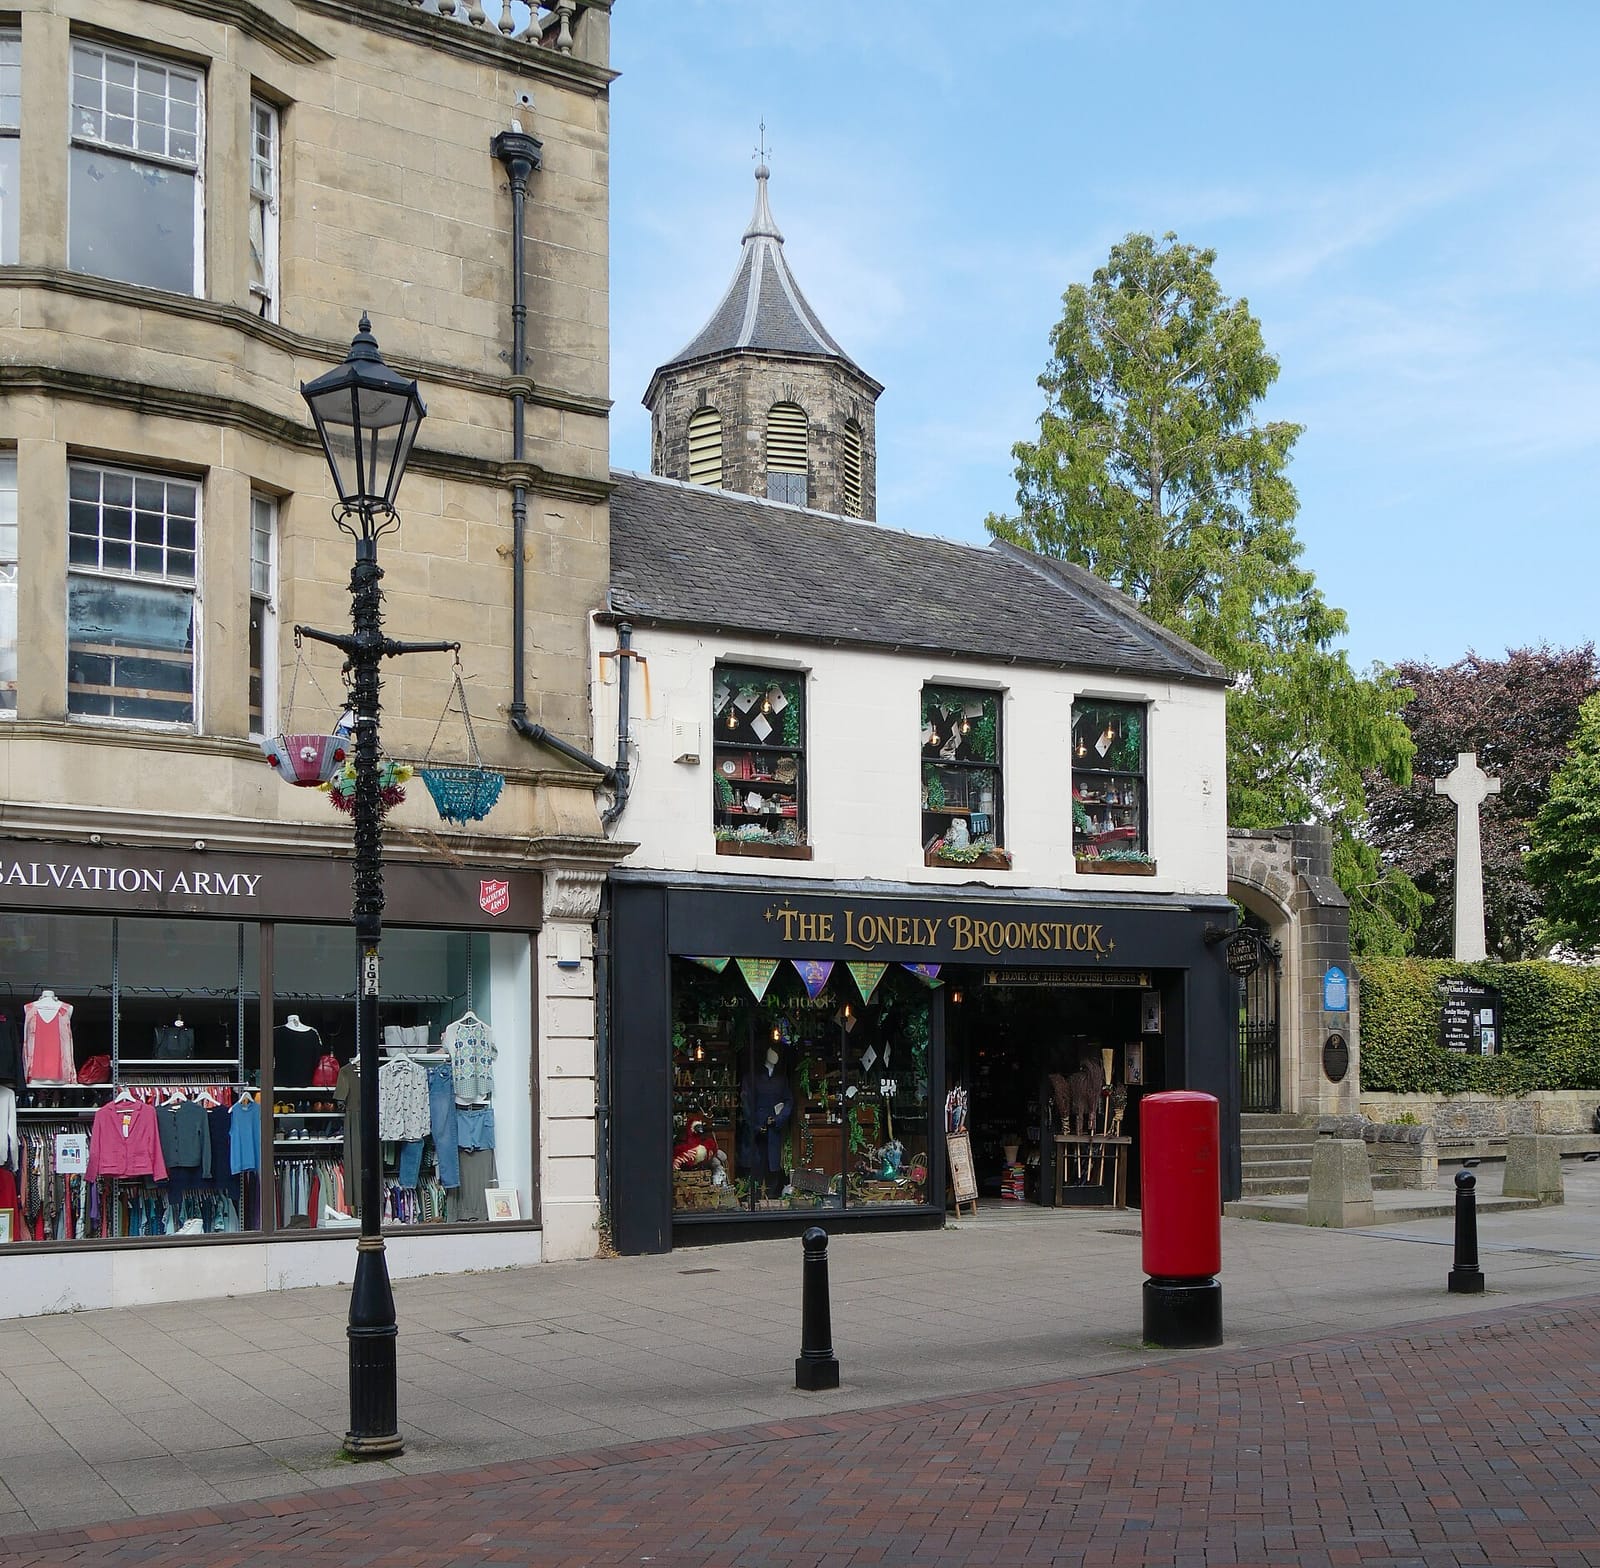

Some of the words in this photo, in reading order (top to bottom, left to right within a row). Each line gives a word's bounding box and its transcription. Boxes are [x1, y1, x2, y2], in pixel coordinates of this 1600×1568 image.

[170, 871, 262, 896] ARMY
[485, 883, 497, 895] THE
[481, 885, 506, 906] SALVATION
[490, 895, 506, 911] ARMY
[776, 909, 835, 943] THE
[843, 910, 942, 952] LONELY
[948, 915, 1107, 955] BROOMSTICK
[1000, 971, 1027, 981] HOME
[1029, 972, 1041, 981] OF
[1043, 972, 1061, 982] THE
[1062, 972, 1103, 982] SCOTTISH
